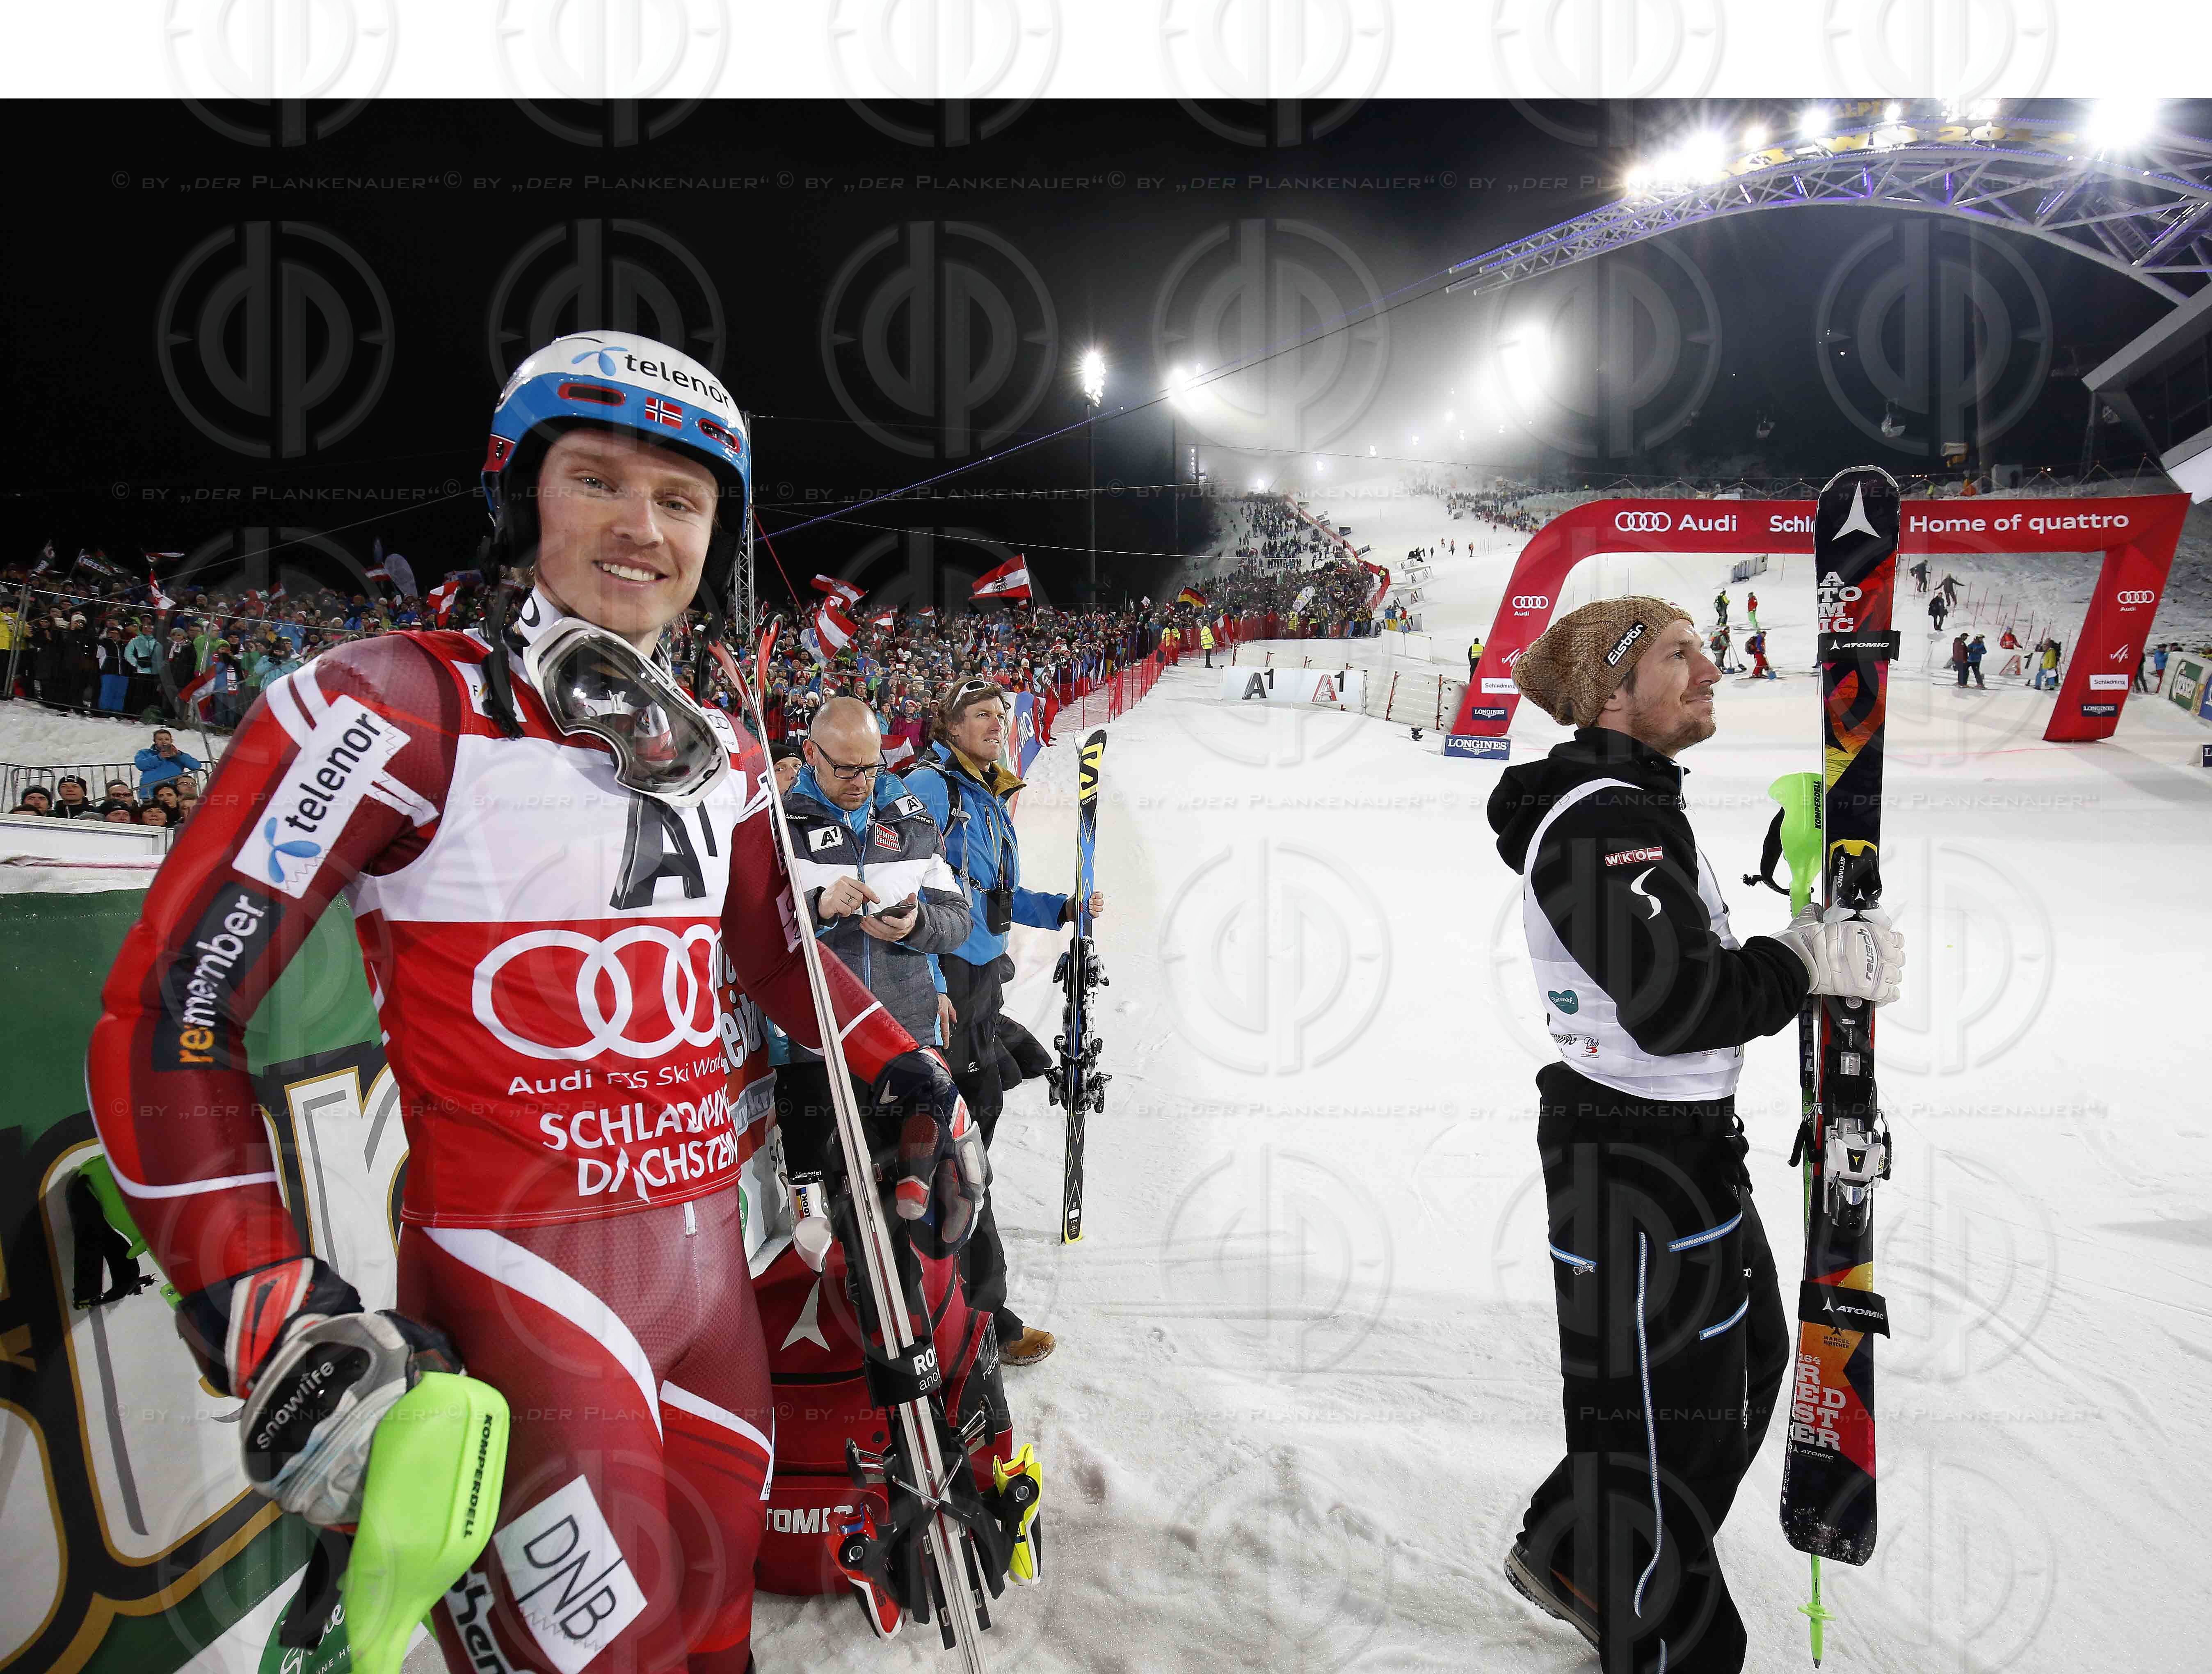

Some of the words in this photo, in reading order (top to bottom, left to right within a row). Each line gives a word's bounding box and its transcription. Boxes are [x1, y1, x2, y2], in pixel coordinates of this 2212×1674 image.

[625, 353, 732, 409] telenor
[1678, 515, 1737, 532] Audi
[1910, 515, 1986, 533] Home
[1994, 514, 2022, 531] of
[2029, 513, 2129, 534] quattro
[1608, 624, 1643, 665] Eisbär
[1241, 668, 1274, 700] A1
[1312, 670, 1344, 702] A1
[1448, 738, 1508, 750] LONGINES
[285, 712, 382, 833] telenor
[1082, 794, 1097, 806] salomon
[821, 826, 839, 846] A1
[876, 826, 897, 841] Kronen
[1606, 850, 1646, 865] WKO
[1837, 856, 1846, 888] ATOMIC
[1858, 928, 1874, 981] reusch
[179, 893, 266, 1065] remember
[507, 1069, 592, 1095] Audi
[656, 1064, 689, 1086] Ski
[801, 1194, 811, 1218] LOOK
[1836, 1305, 1884, 1320] ATOMIC
[1823, 1340, 1849, 1349] HIRSCHER
[1824, 1335, 1850, 1344] MARCEL
[256, 1358, 336, 1451] snowlife
[1800, 1449, 1835, 1460] ATOMIC
[463, 1414, 493, 1539] KOMPERDELL
